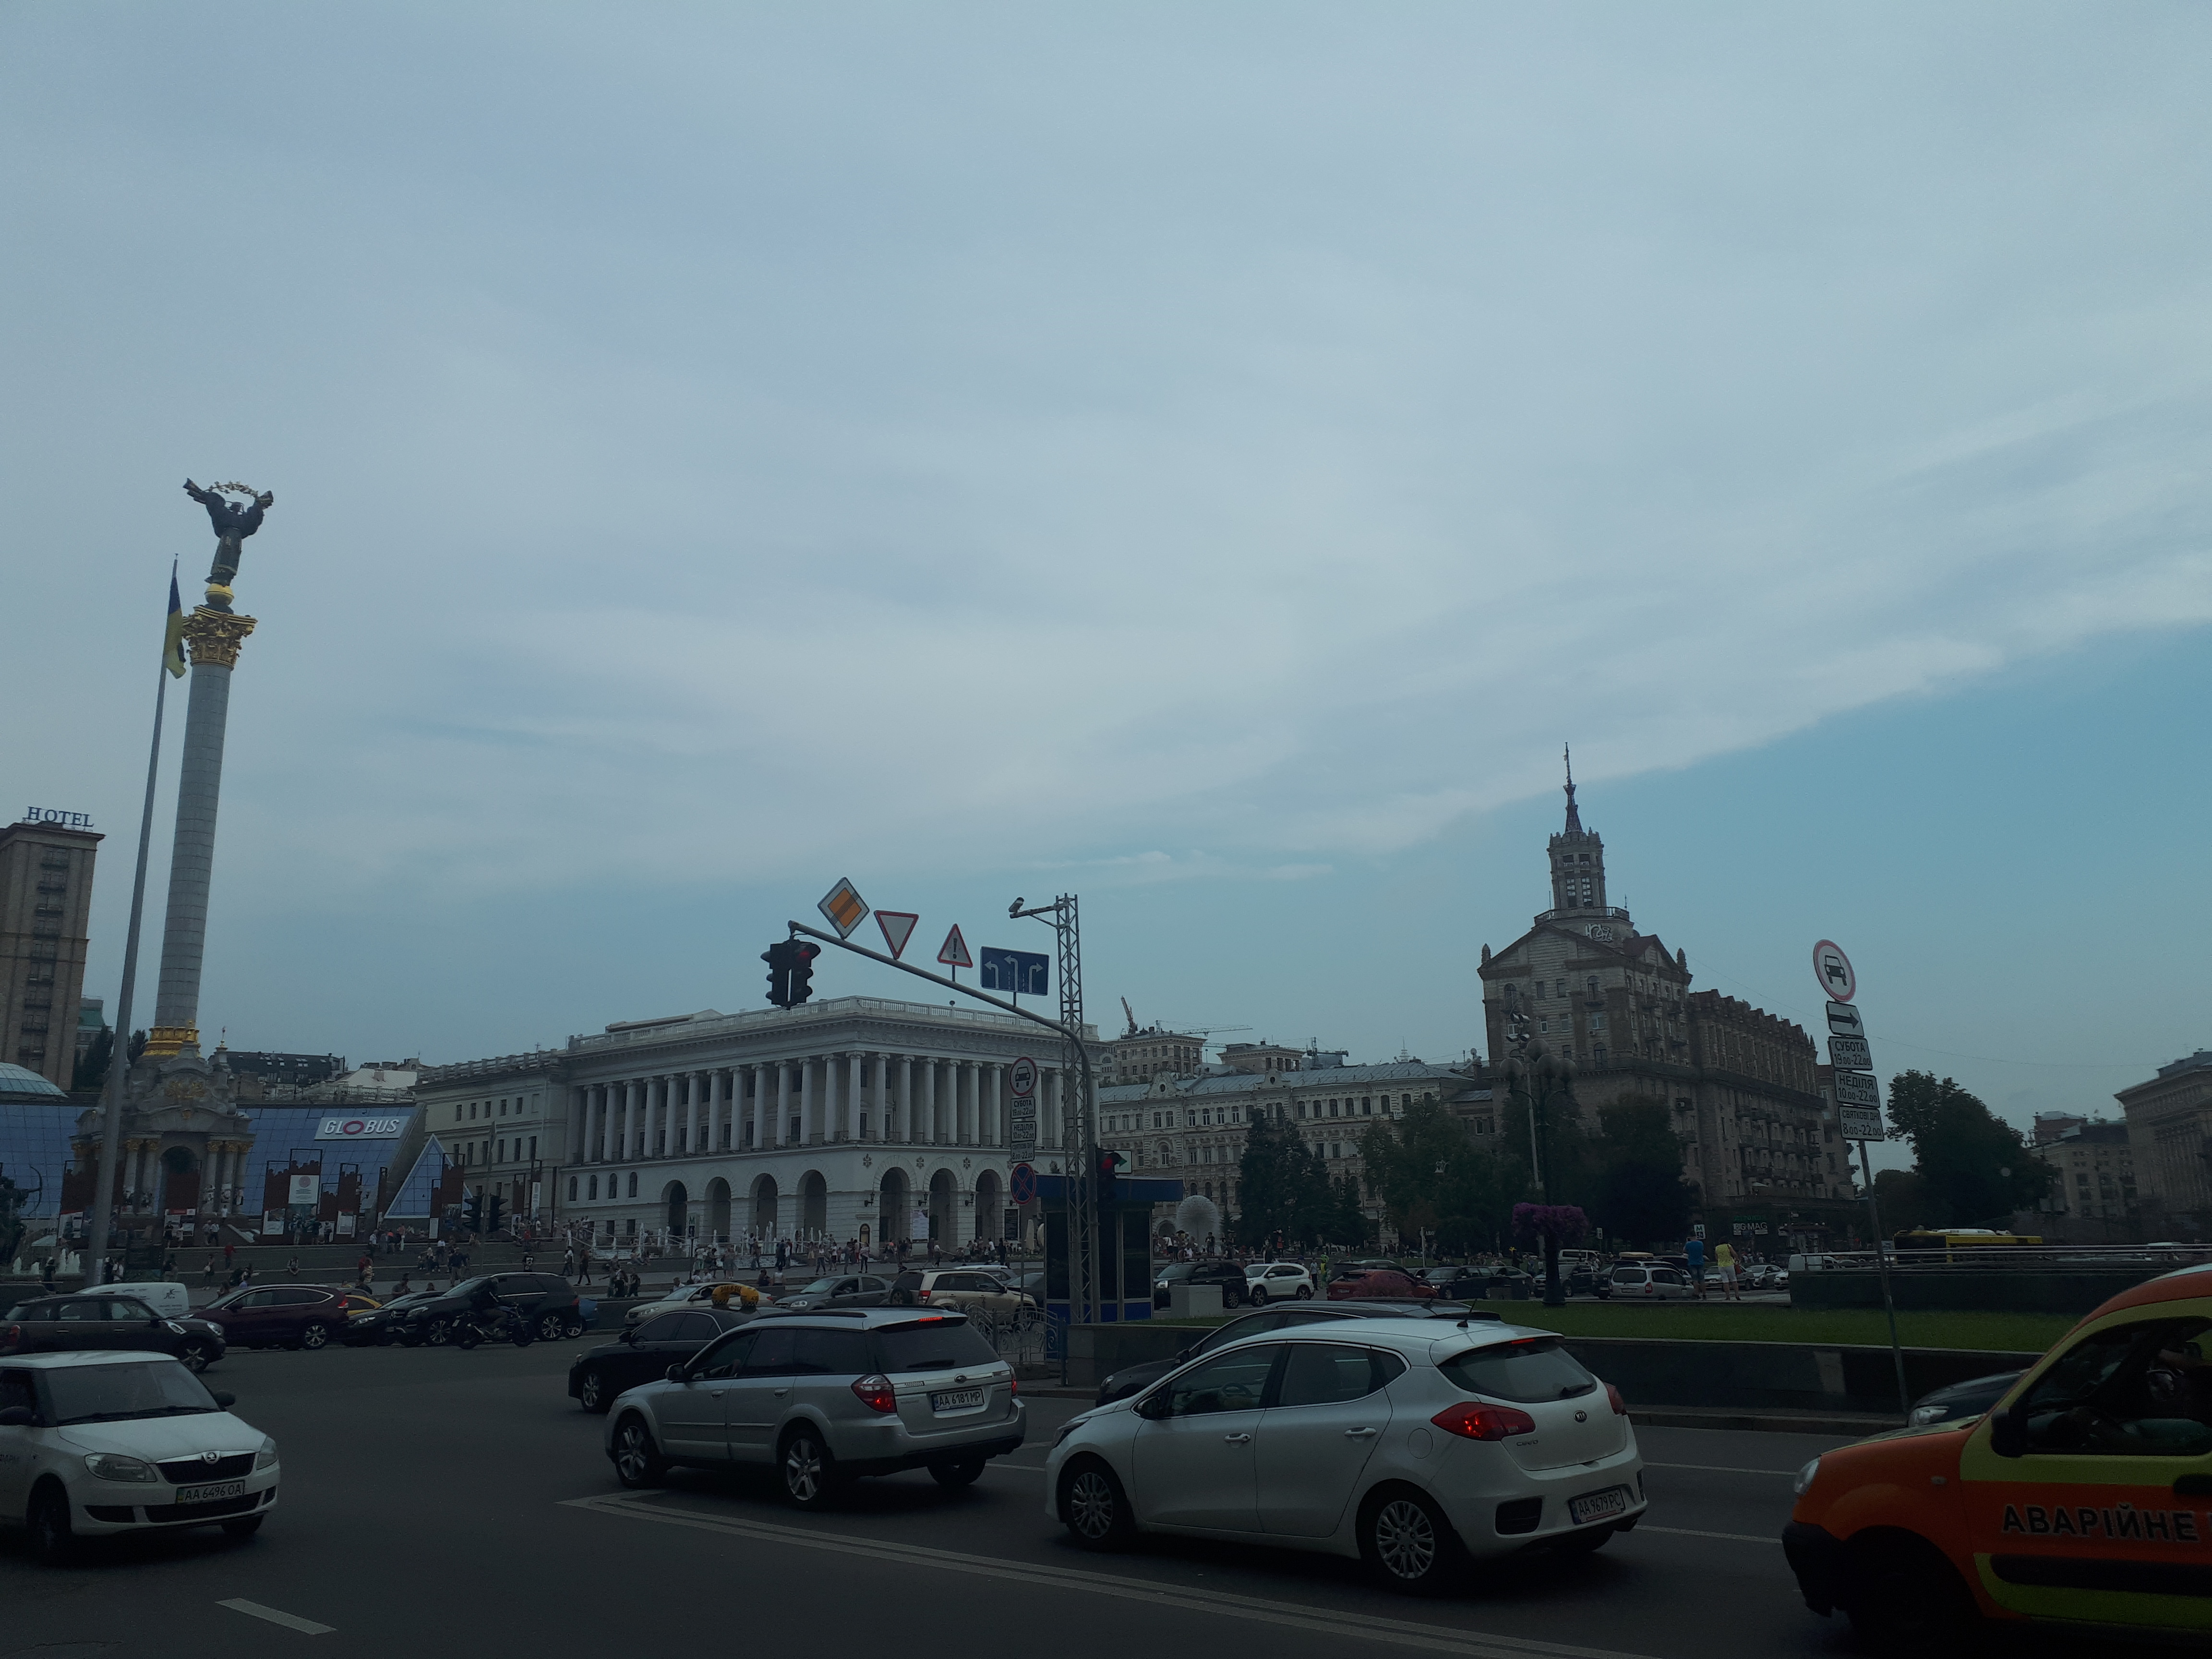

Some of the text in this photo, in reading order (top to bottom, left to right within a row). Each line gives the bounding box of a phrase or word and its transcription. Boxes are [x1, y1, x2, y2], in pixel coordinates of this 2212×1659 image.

[27, 806, 94, 827] HOTEL
[1835, 1041, 1865, 1052] СУБОТА
[1839, 1074, 1874, 1090] НЕДІЛЯ
[1014, 1099, 1032, 1107] СУБОТА
[1842, 1109, 1879, 1122] СВЯТКОВІ ДНІ
[324, 1119, 399, 1134] GLOBUS
[1014, 1123, 1033, 1132] НЕДІЛЯ
[1747, 1222, 1768, 1230] MAG
[939, 1392, 981, 1407] AA 6181 MP
[1575, 1412, 1587, 1421] KIA
[184, 1489, 200, 1502] AA
[202, 1485, 226, 1499] 6496
[1578, 1500, 1591, 1516] AA
[1590, 1496, 1609, 1513] 9679
[2002, 1502, 2200, 1542] АВАРІЙНЕ
